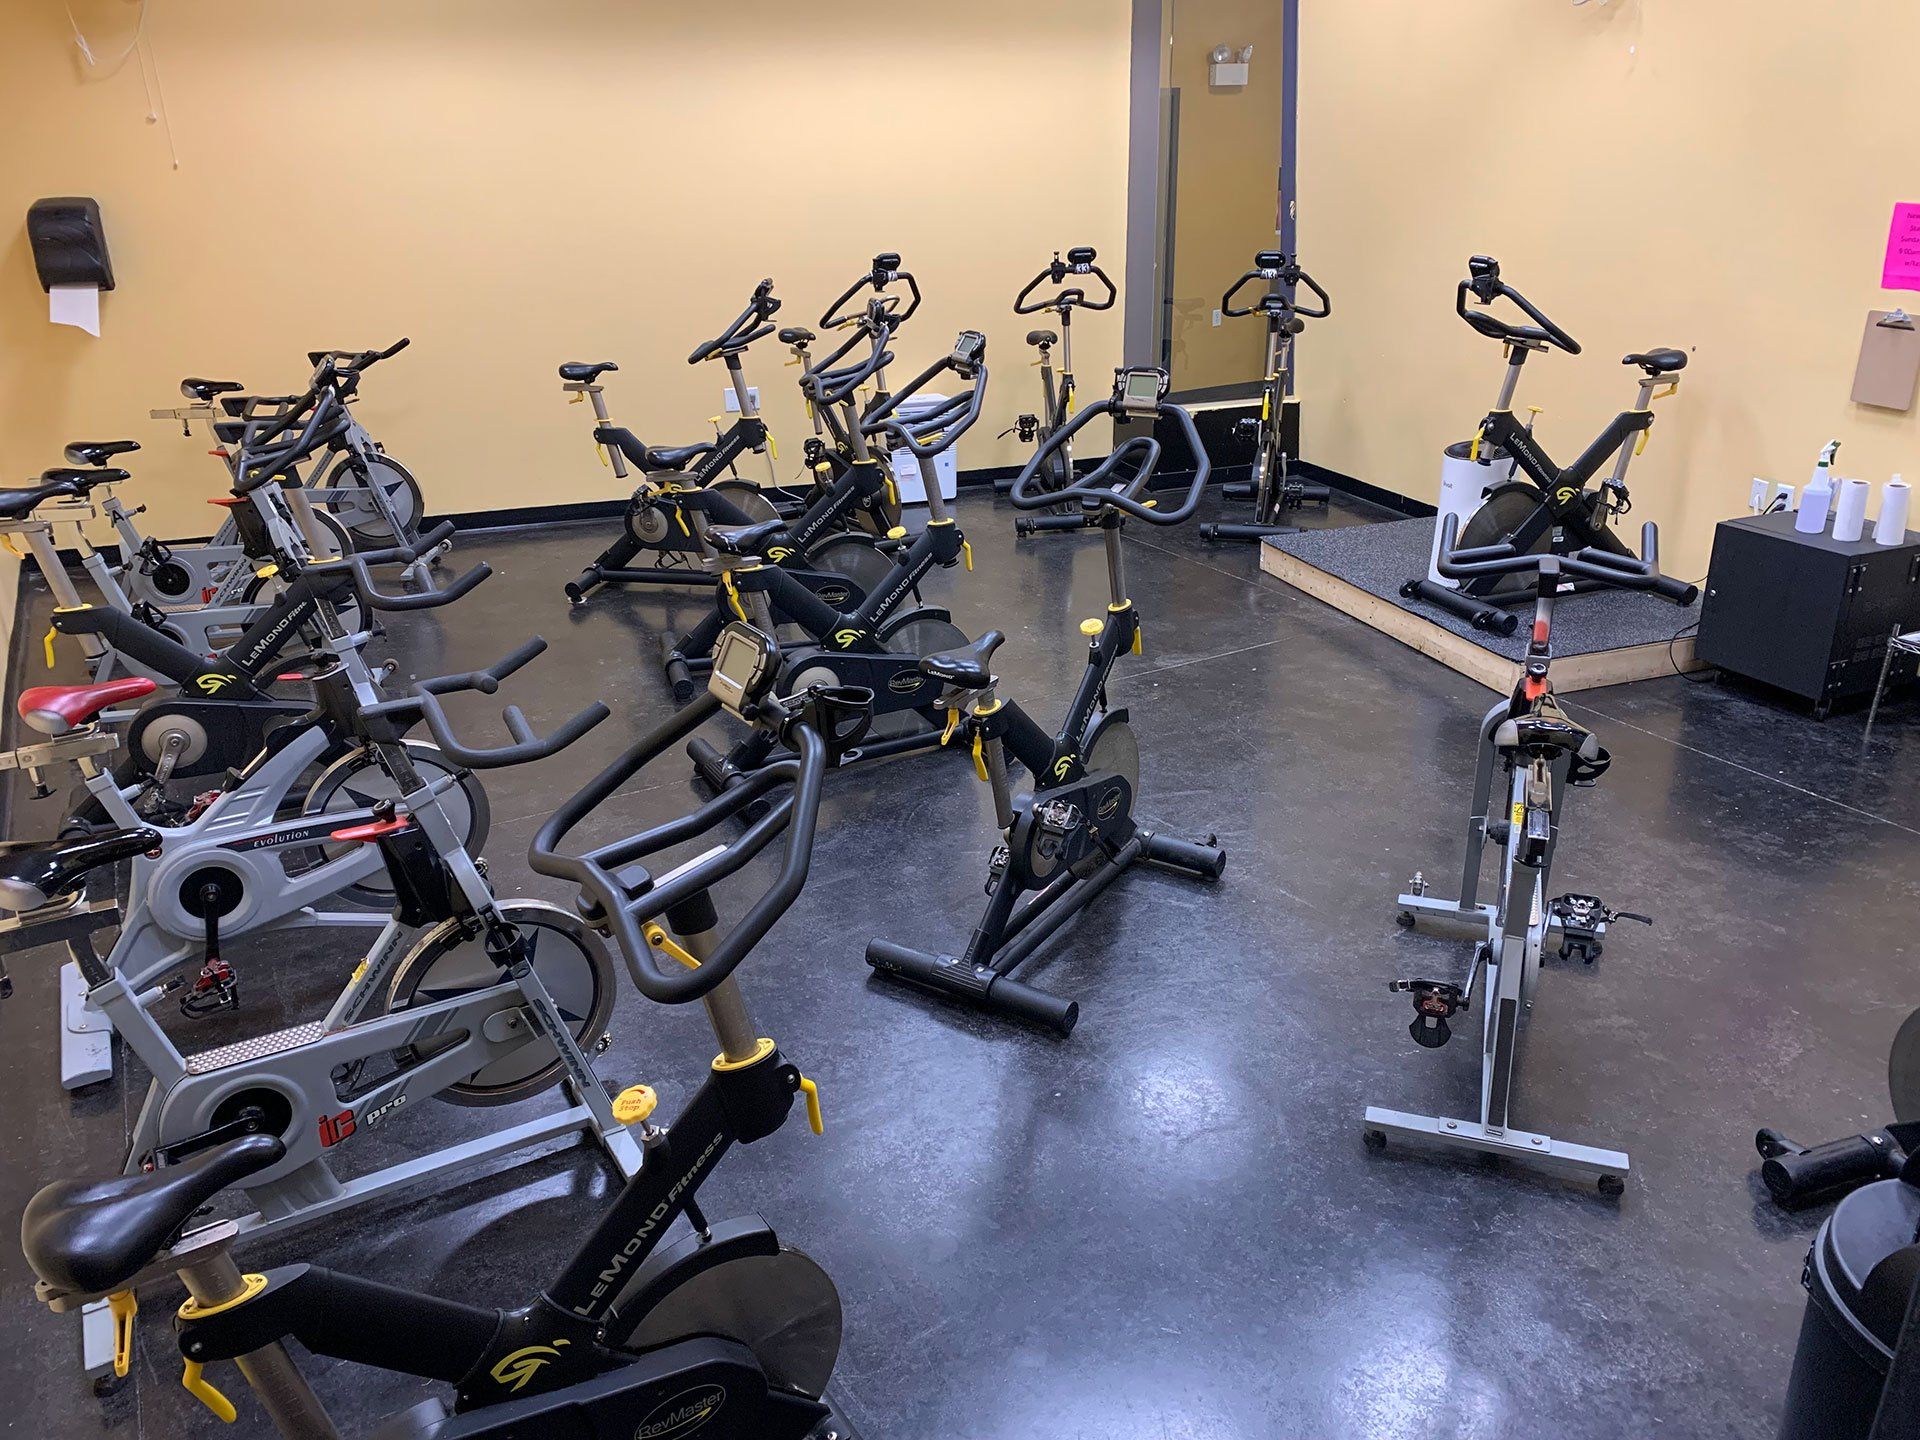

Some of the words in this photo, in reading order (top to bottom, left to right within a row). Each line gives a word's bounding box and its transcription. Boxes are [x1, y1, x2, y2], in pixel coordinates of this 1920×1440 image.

[343, 931, 403, 1023] SCHWINN
[533, 998, 592, 1089] SCHWINN
[365, 1093, 408, 1127] pro
[667, 1132, 724, 1203] Fitness
[638, 1390, 723, 1440] RevMaster
